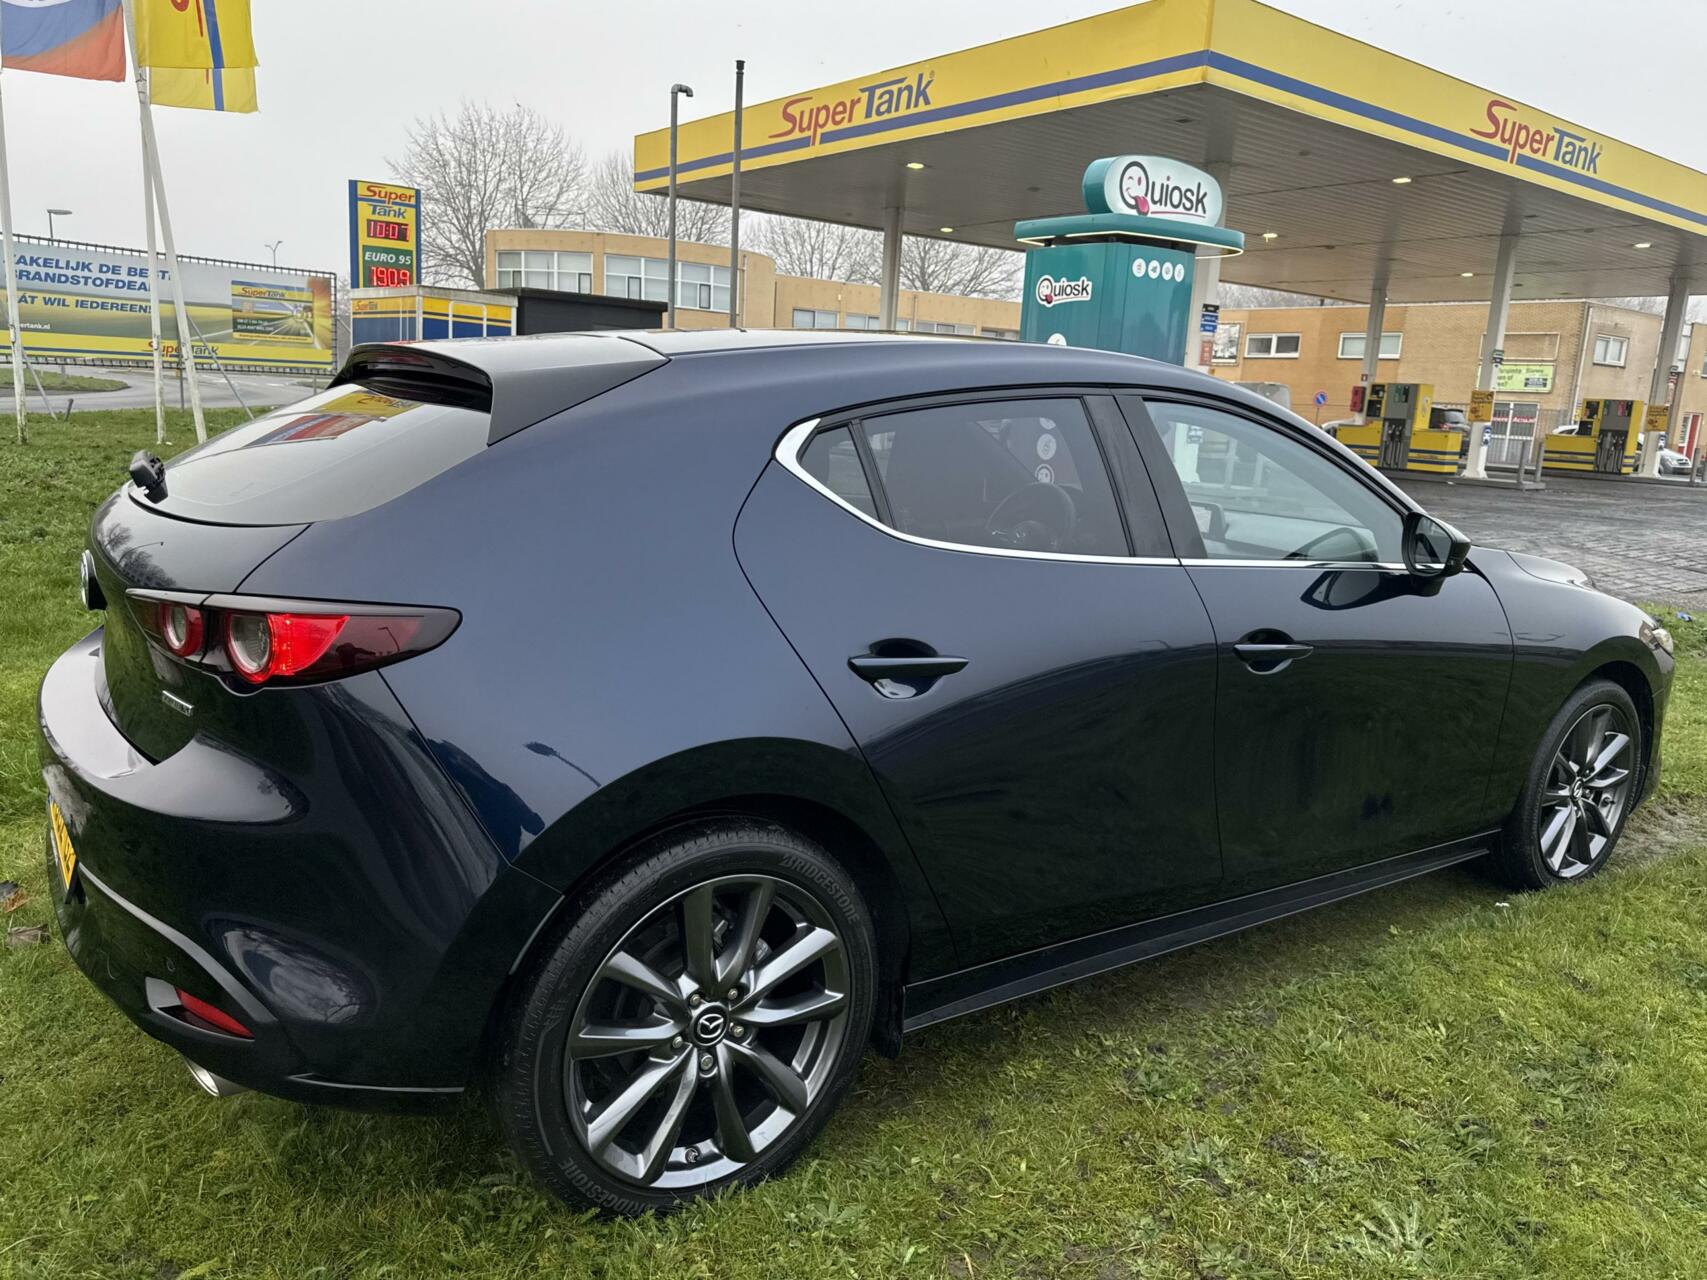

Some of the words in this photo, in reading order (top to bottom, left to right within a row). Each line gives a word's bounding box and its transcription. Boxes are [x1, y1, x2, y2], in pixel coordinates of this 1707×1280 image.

[768, 72, 934, 146] SuperTank
[1469, 99, 1602, 174] SuperTank
[357, 185, 415, 205] Super
[1119, 160, 1208, 216] Quiosk
[368, 204, 407, 219] Tank
[369, 221, 409, 241] 10:07
[14, 254, 93, 273] AKELIJK
[99, 263, 122, 276] DE
[127, 266, 171, 281] BET
[364, 251, 396, 263] EURO
[398, 254, 412, 265] 95
[17, 292, 39, 304] ÁT
[43, 296, 71, 308] WIL
[75, 299, 152, 314] IEDEREEN!
[1038, 277, 1090, 304] Quiosk
[779, 853, 860, 925] BRIDGESTONE
